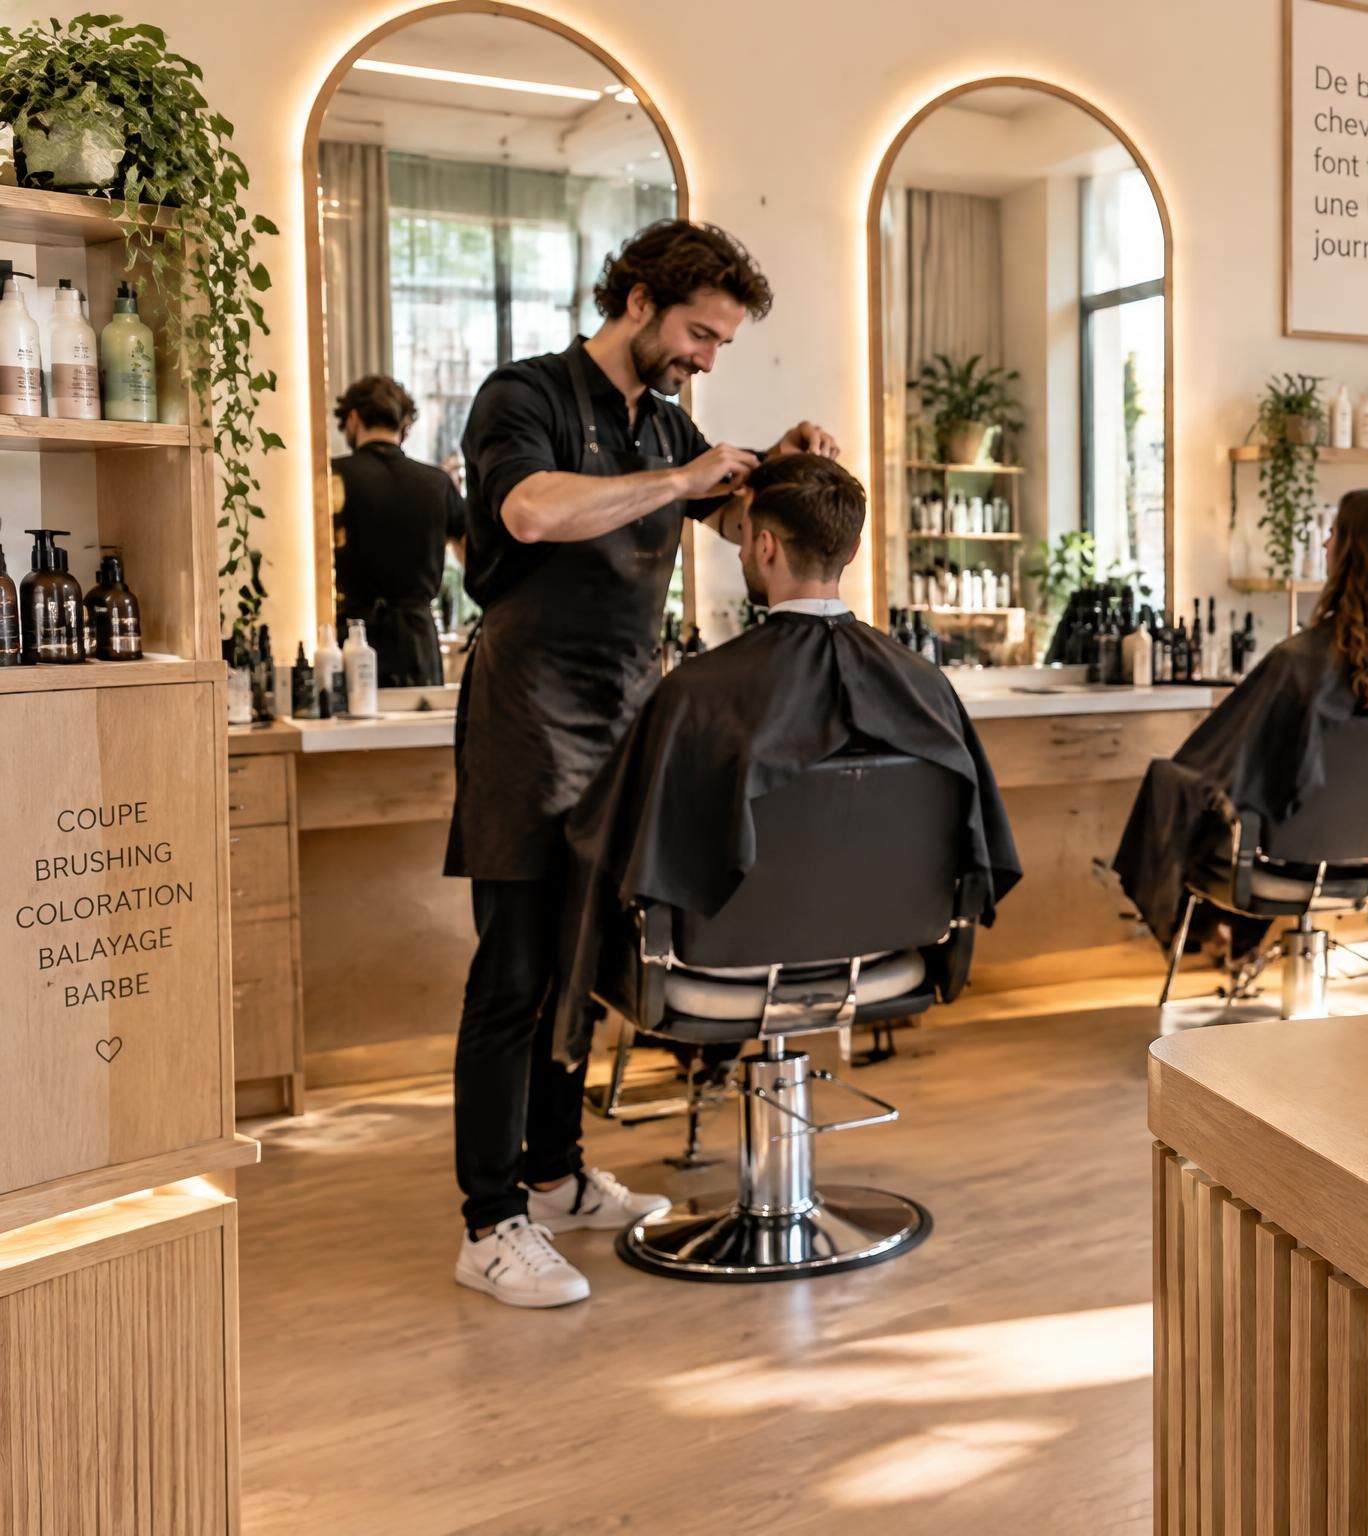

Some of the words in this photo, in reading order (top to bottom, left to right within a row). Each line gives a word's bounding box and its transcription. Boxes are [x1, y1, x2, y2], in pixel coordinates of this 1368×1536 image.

[1316, 65, 1347, 94] De
[1314, 147, 1359, 177] font
[1315, 196, 1358, 217] une
[57, 802, 147, 832] COUPE
[36, 842, 171, 881] BRUSHING
[16, 882, 192, 929] COLORATION
[40, 927, 172, 970] BALAYAGE
[65, 973, 149, 1007] BARBE
